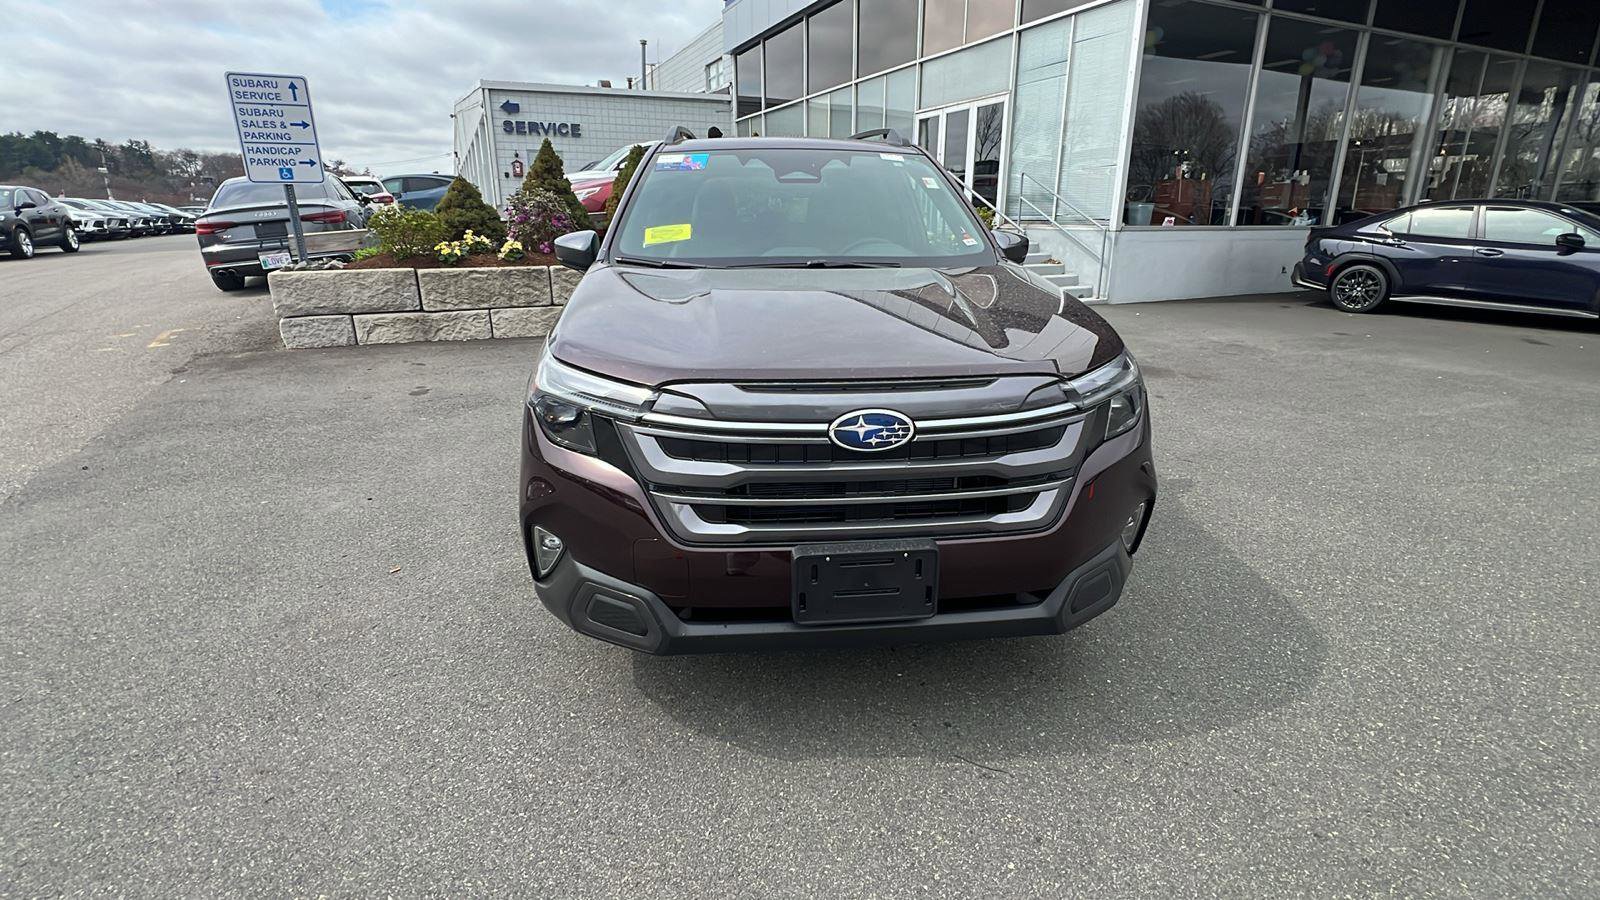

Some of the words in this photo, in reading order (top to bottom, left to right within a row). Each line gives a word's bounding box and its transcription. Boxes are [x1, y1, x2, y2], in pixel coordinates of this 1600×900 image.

[232, 78, 278, 89] SUBARU
[235, 91, 282, 101] SERVICE
[239, 108, 284, 118] SUBARU
[241, 120, 277, 129] SALES
[279, 121, 287, 129] &
[502, 119, 582, 138] SERVICE
[243, 131, 292, 141] PARKING
[247, 146, 302, 155] HANDICAP
[249, 157, 297, 167] PARKING
